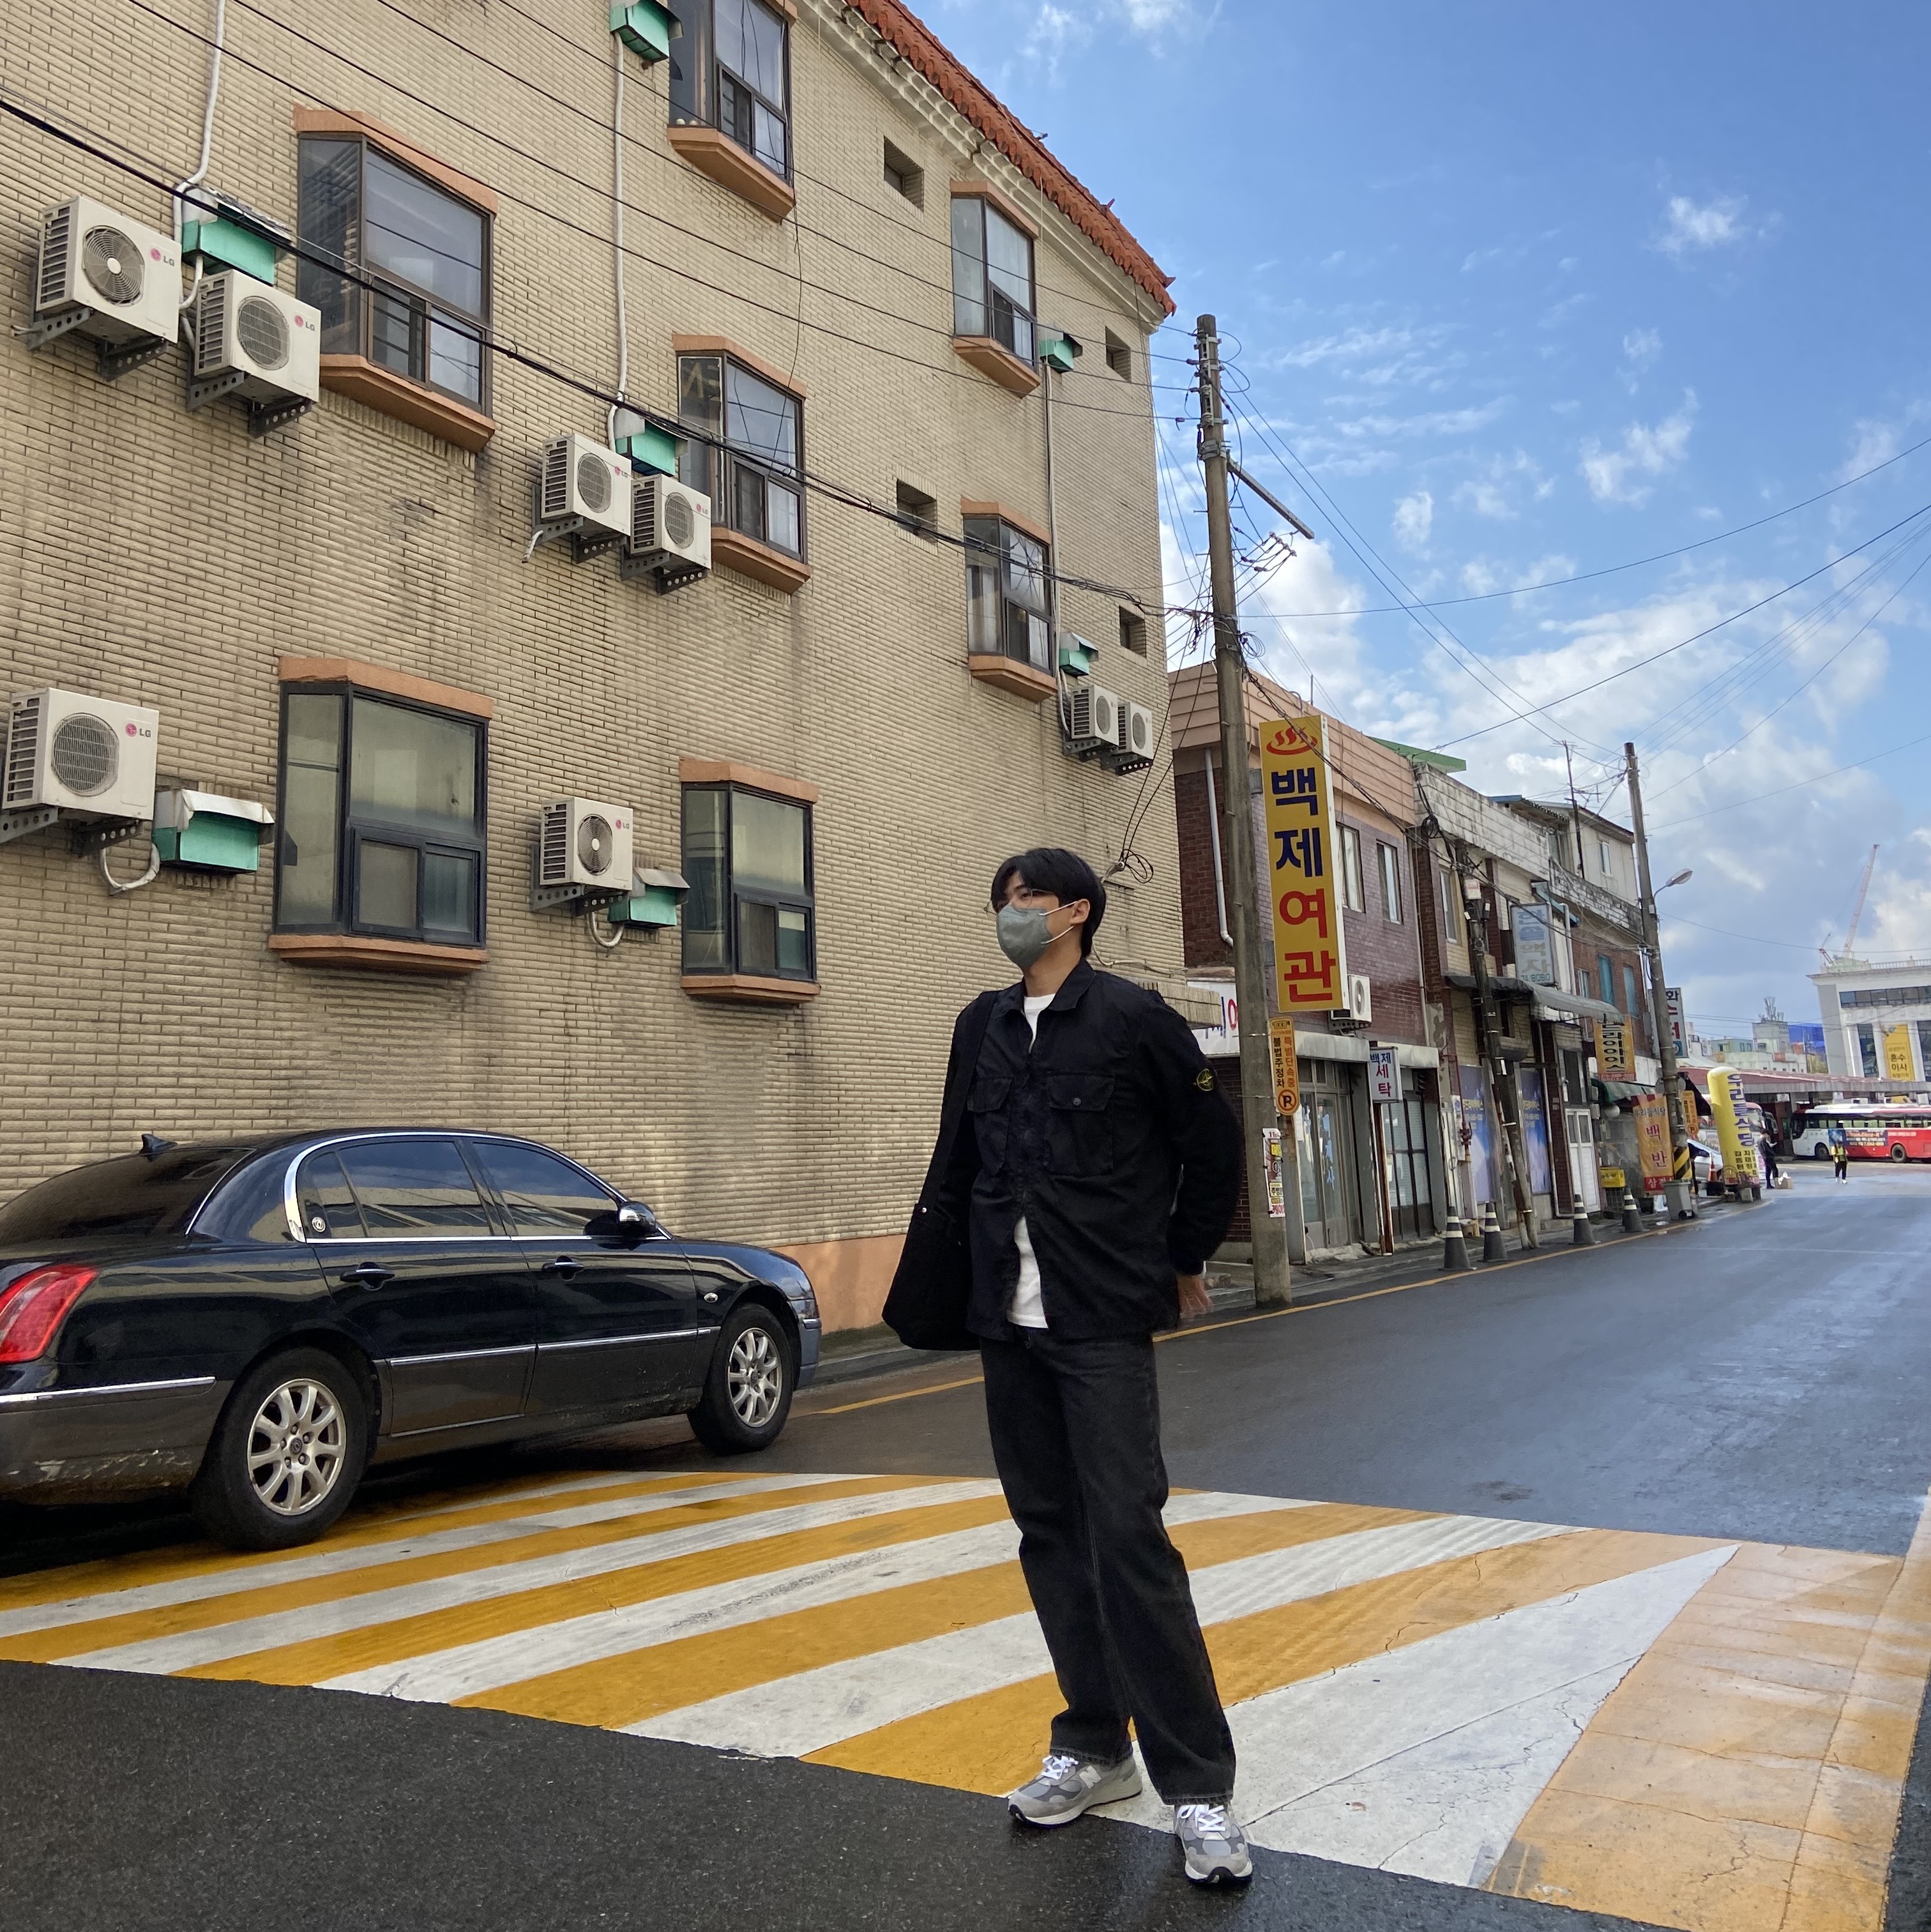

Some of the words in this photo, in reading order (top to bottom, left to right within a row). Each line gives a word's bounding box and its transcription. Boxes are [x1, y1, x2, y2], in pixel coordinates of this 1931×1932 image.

[163, 255, 174, 266] LG
[305, 321, 315, 331] LG
[139, 728, 151, 738] LG
[1271, 767, 1337, 1003] 백제여관
[1273, 1037, 1285, 1088] 불법주정차
[1284, 1037, 1295, 1088] 특별단속중
[1370, 1052, 1391, 1065] 백제
[1376, 1064, 1391, 1097] 세탁
[1635, 1106, 1666, 1118] 우리들식당
[1646, 1124, 1668, 1168] 백반
